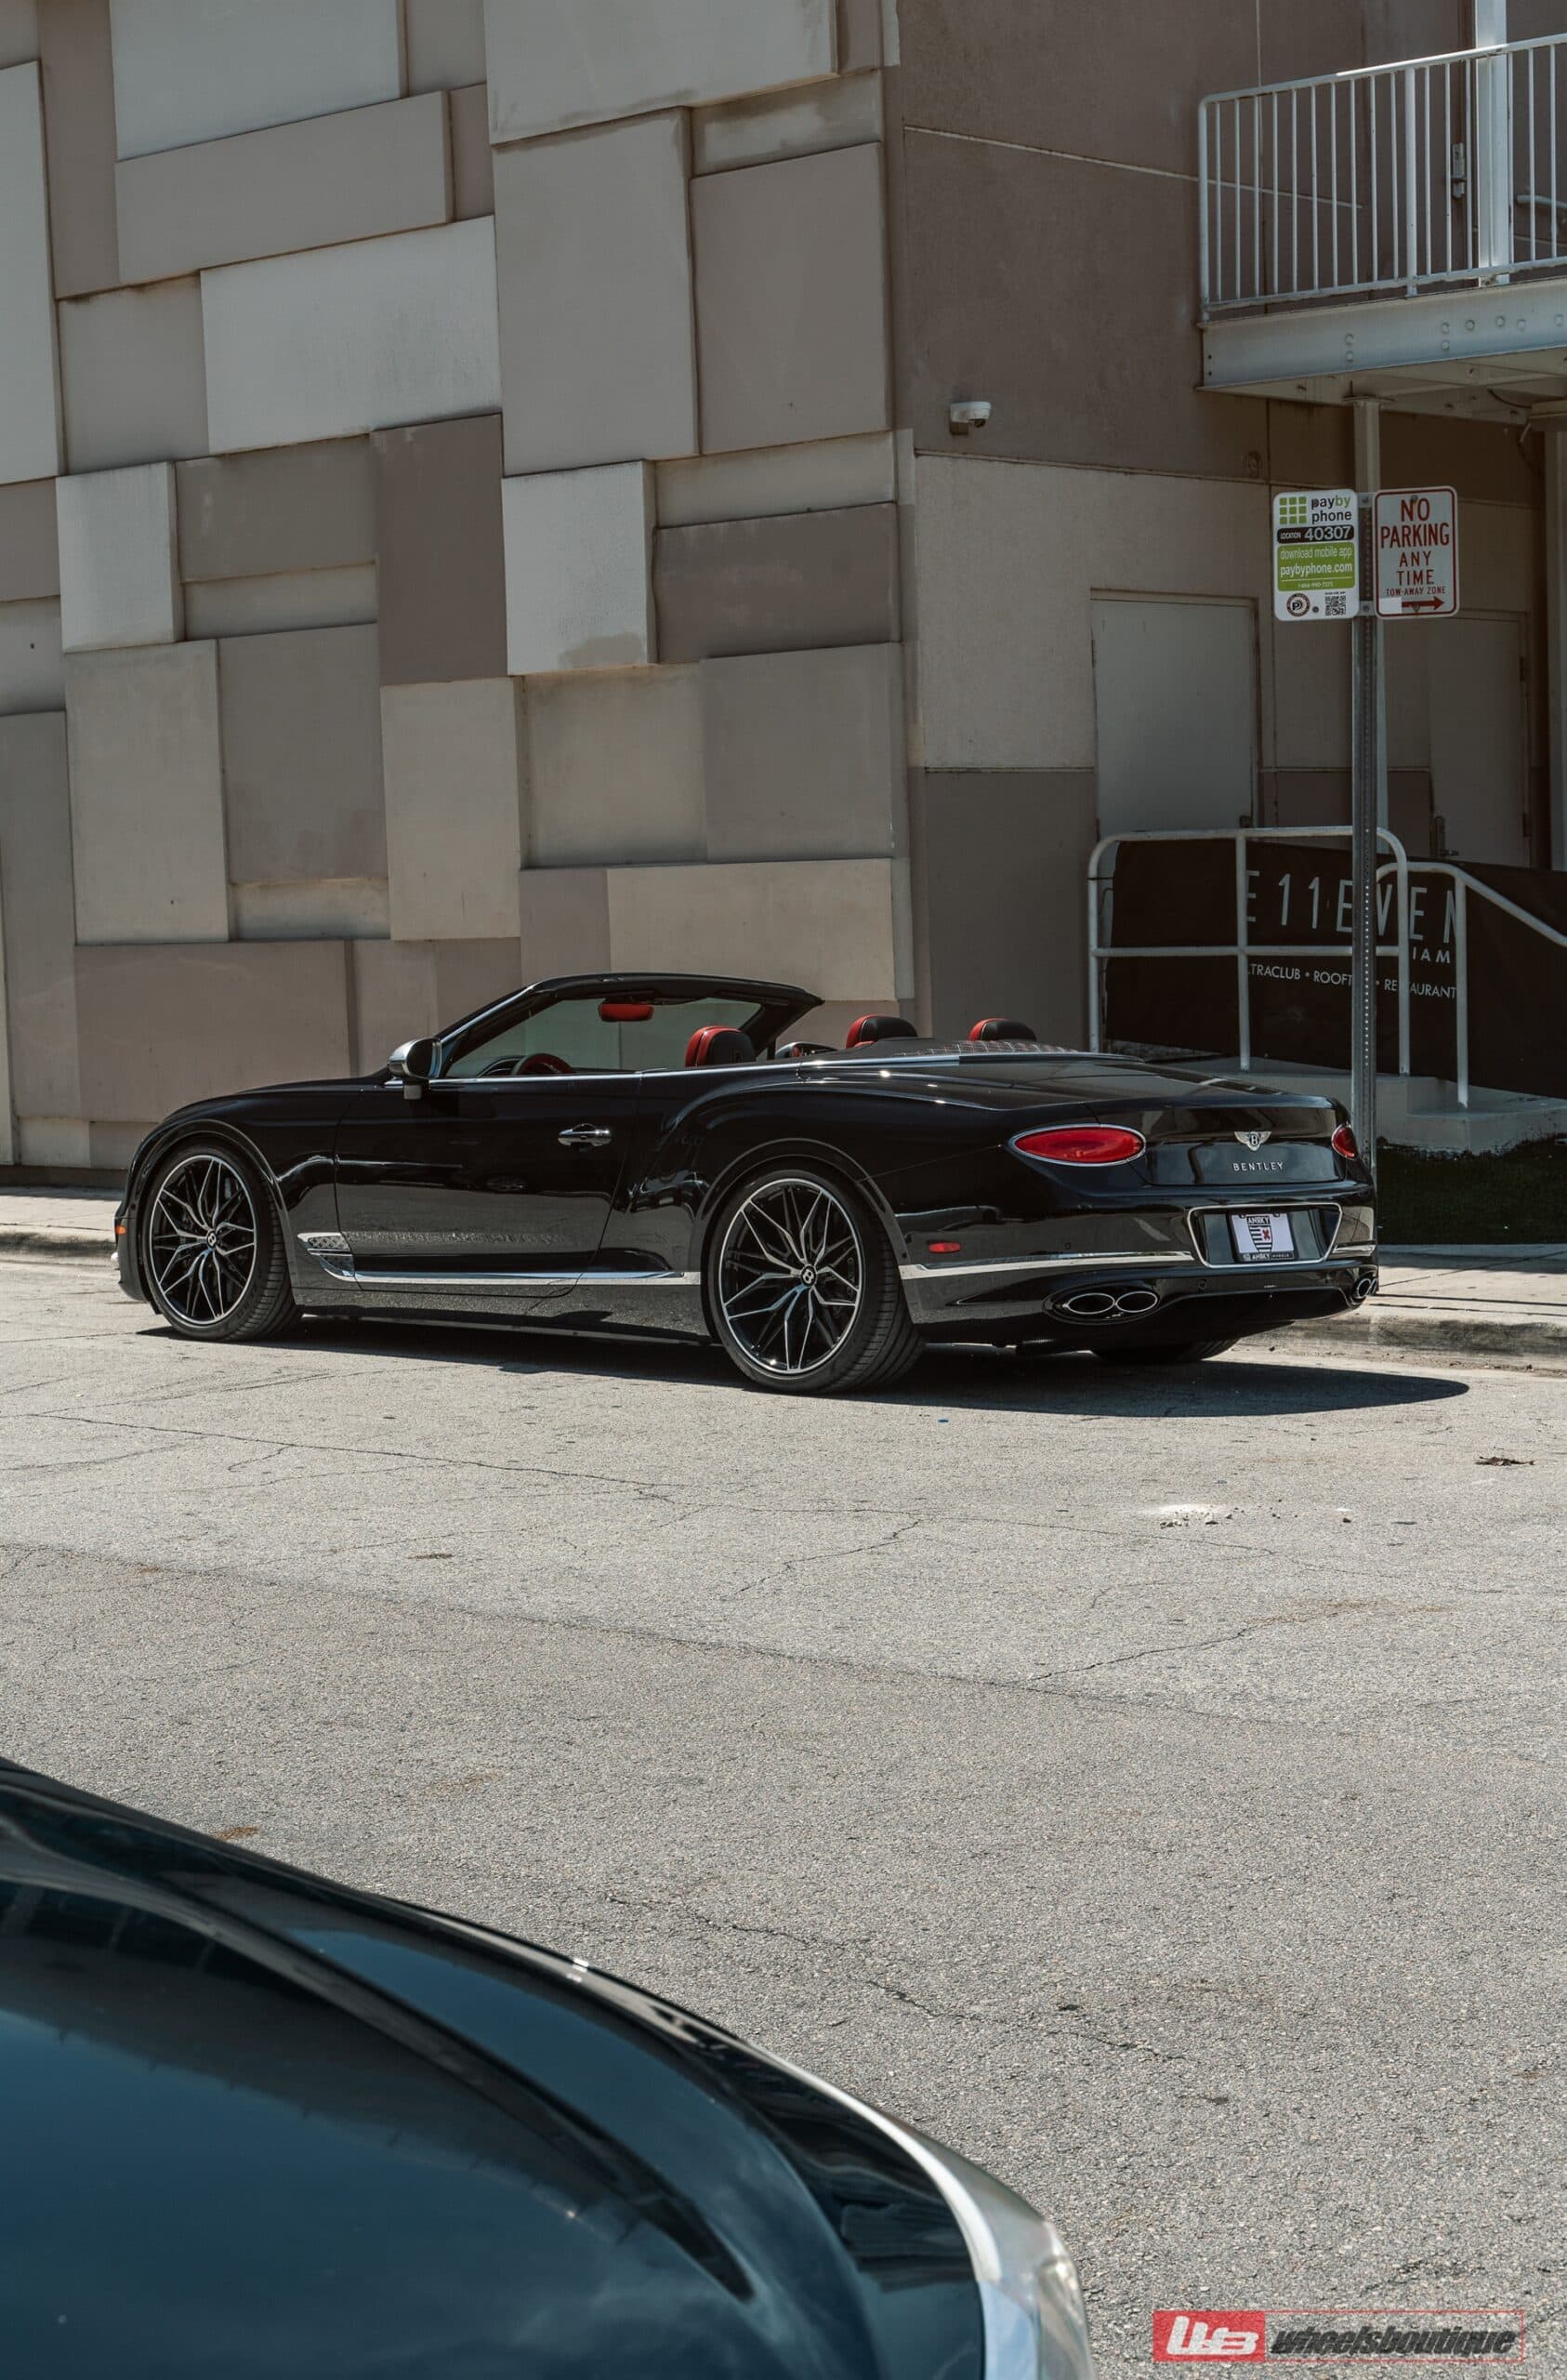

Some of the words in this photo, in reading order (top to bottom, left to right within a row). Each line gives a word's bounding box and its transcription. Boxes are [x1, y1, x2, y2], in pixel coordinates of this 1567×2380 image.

[1311, 510, 1352, 524] phone
[1401, 497, 1430, 522] NO
[1304, 526, 1351, 541] 40307
[1380, 522, 1450, 549] PARKING
[1280, 548, 1312, 560] download
[1314, 547, 1337, 558] mobile
[1338, 547, 1351, 560] app
[1399, 550, 1431, 567] ANY
[1280, 562, 1353, 577] paybyphone.com
[1396, 569, 1435, 586] TIME
[1386, 587, 1424, 596] TOW-AWAY
[1427, 586, 1446, 595] ZONE
[1249, 963, 1301, 981] TRACLUB
[1313, 971, 1353, 987] ROOFT
[1384, 978, 1457, 999] REAURANT
[1232, 1161, 1284, 1171] BENTLEY
